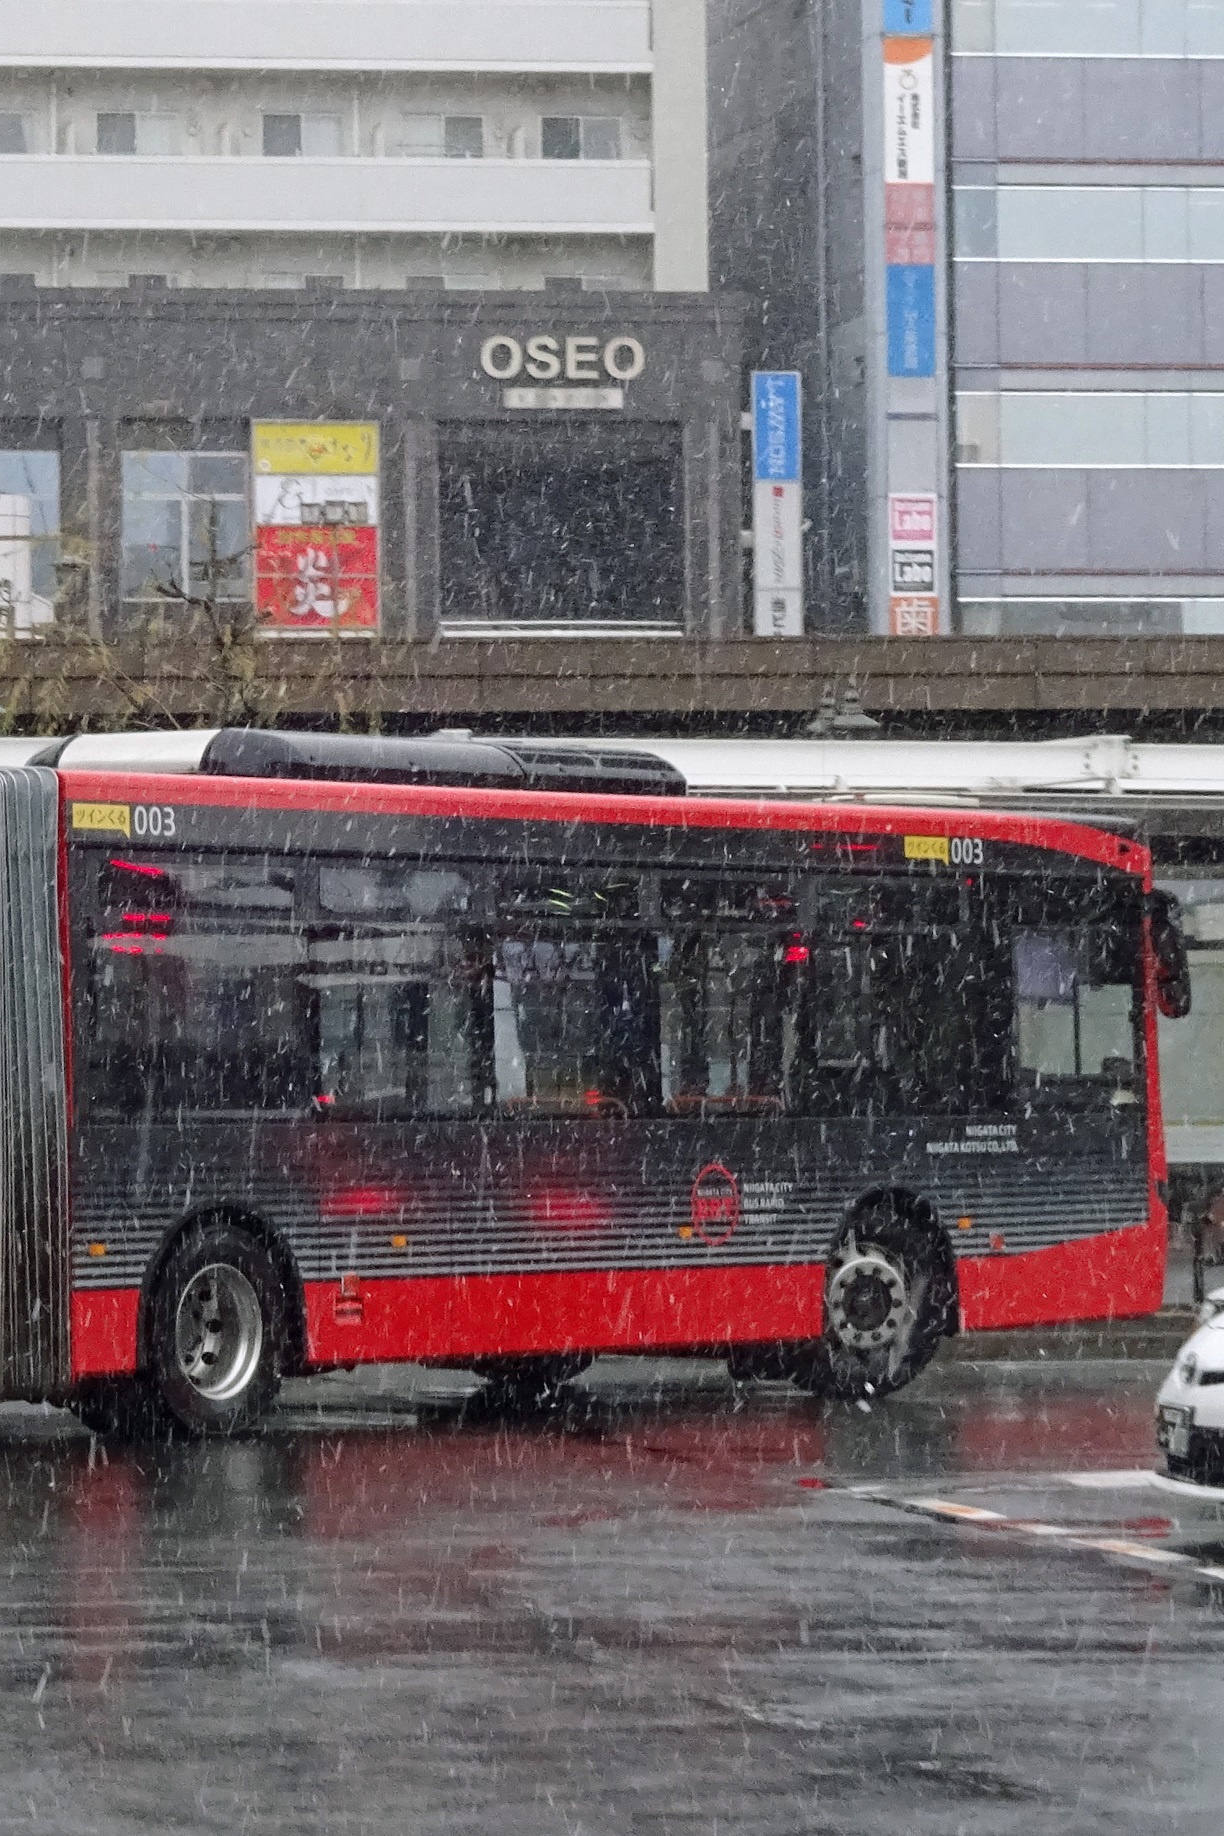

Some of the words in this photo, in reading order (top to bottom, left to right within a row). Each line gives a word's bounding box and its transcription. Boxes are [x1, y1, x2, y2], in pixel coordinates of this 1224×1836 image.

[480, 335, 646, 380] OSEO
[766, 376, 786, 475] LAWSON
[895, 598, 935, 635] 歯
[134, 806, 176, 836] 003
[950, 838, 984, 864] 003
